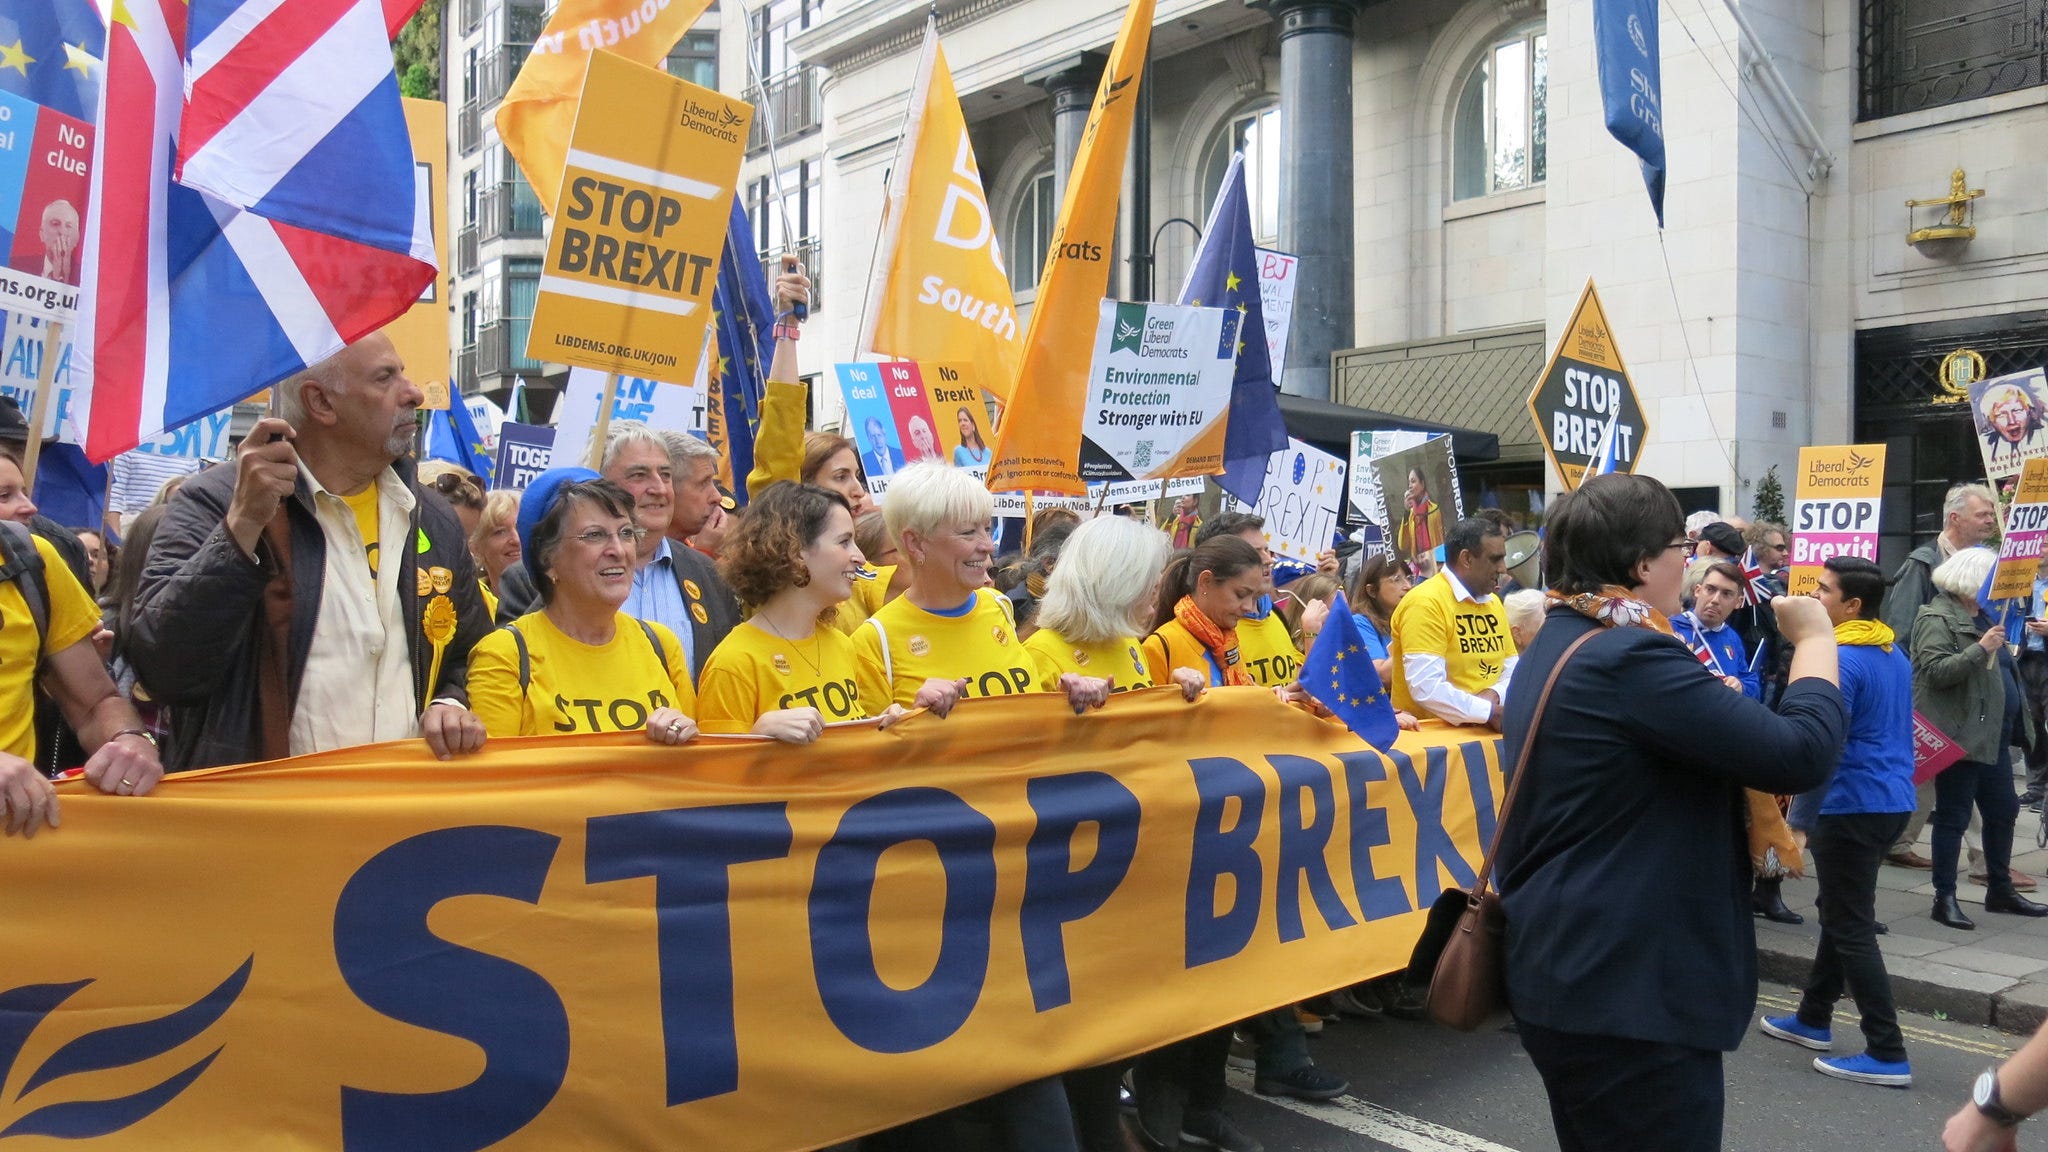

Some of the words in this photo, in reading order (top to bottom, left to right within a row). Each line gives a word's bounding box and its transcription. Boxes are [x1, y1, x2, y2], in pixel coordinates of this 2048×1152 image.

[683, 100, 719, 122] Liberal
[59, 123, 86, 149] No
[681, 113, 738, 144] Democrats
[47, 149, 87, 176] clue
[567, 176, 682, 239] STOP
[558, 227, 713, 297] BREXIT
[1147, 316, 1174, 330] Green
[1144, 331, 1172, 345] Liberal
[555, 333, 678, 367] LIBDEMS.ORG.UK/JOIN
[1141, 345, 1188, 359] Democrats
[850, 368, 867, 382] No
[891, 367, 910, 381] No
[938, 367, 959, 382] No
[1105, 366, 1201, 386] Environmental
[852, 386, 877, 400] deal
[894, 384, 918, 398] clue
[934, 386, 976, 403] Brexit
[1101, 388, 1171, 406] Protection
[1564, 368, 1621, 416] STOP
[1098, 409, 1158, 430] Stronger
[1160, 410, 1187, 427] with
[1189, 410, 1203, 426] EU
[1810, 459, 1845, 474] Liberal
[1808, 474, 1870, 488] Democrats
[1799, 502, 1873, 531] STOP
[2011, 505, 2048, 531] STOP
[1793, 536, 1873, 563] Brexit
[2001, 534, 2043, 559] Brexit
[1797, 575, 1815, 587] Join
[1456, 614, 1498, 636] STOP
[1460, 636, 1504, 654] BREXIT
[554, 690, 669, 732] STOP
[332, 769, 1142, 1152] STOP
